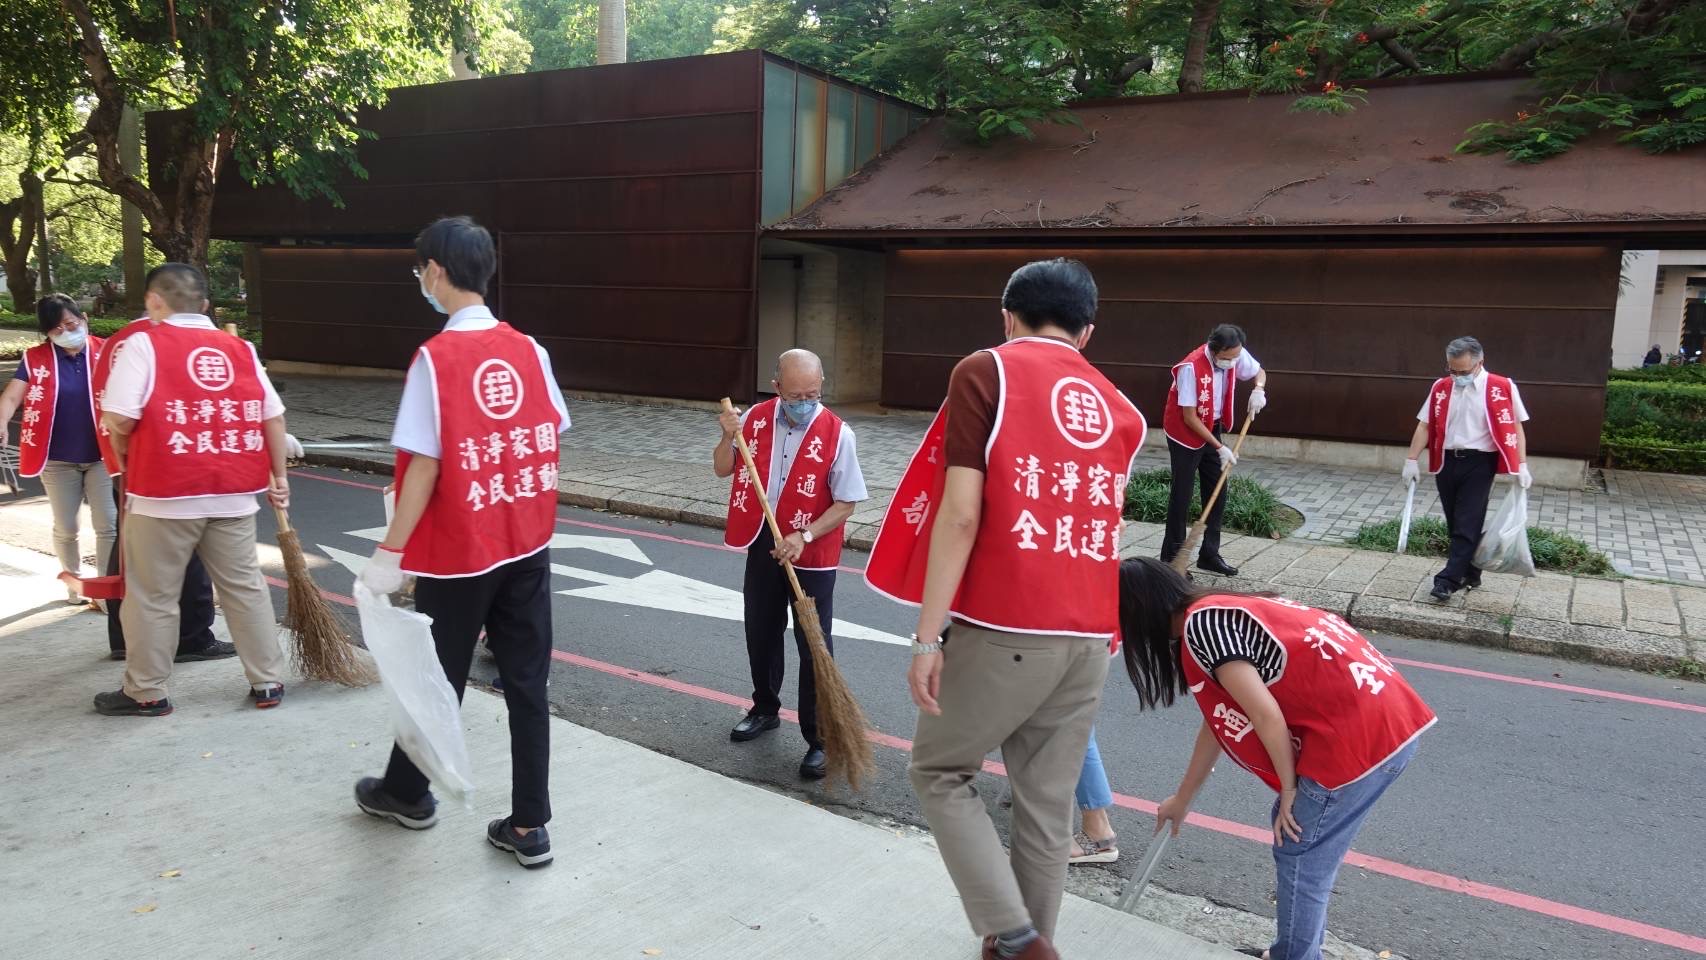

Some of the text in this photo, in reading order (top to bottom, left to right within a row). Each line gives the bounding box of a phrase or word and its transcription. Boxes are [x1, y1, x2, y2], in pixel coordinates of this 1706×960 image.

[20, 365, 50, 447] 中華郵政
[165, 399, 262, 424] 清淨家園
[1198, 373, 1212, 424] 中華郵
[1490, 386, 1518, 448] 交通部
[167, 430, 264, 454] 全民運動
[458, 422, 557, 471] 清淨家園
[789, 436, 824, 530] 交通部
